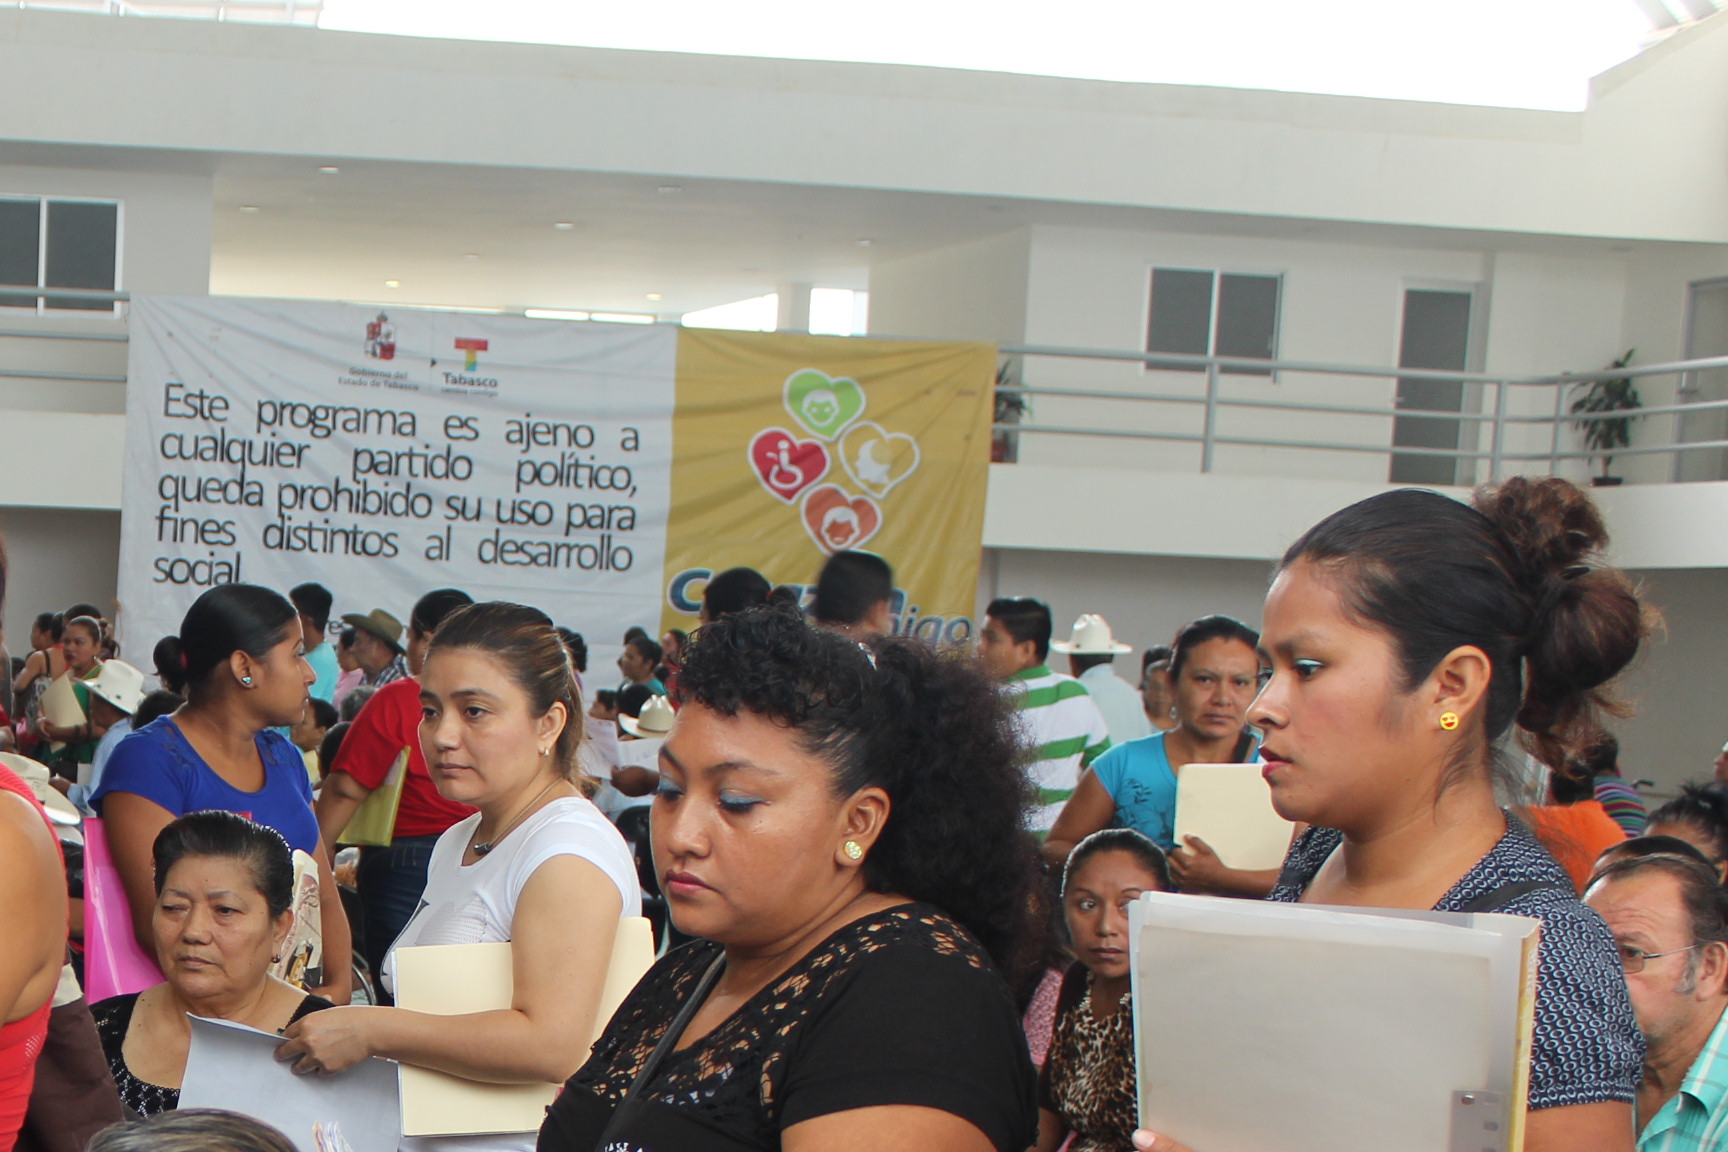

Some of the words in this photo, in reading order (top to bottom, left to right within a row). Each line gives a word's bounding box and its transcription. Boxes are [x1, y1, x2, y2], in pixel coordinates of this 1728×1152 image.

[338, 376, 368, 387] Estado
[369, 379, 381, 388] de
[383, 380, 420, 391] Tabasco
[349, 366, 391, 378] Gobierno
[442, 372, 498, 387] Tabasco
[164, 383, 229, 422] Este
[257, 396, 416, 438] programa
[444, 414, 479, 440] es
[505, 413, 594, 453] ajeno
[620, 426, 639, 452] a
[159, 427, 310, 471] cualquier
[353, 444, 474, 482] partido
[516, 453, 638, 497] político,
[158, 464, 264, 511] queda
[278, 478, 433, 520] prohibido
[445, 496, 482, 522] su
[497, 499, 553, 527] uso
[565, 502, 636, 535] para
[154, 507, 236, 548] fines
[262, 515, 399, 558] distintos
[425, 526, 451, 561] al
[478, 530, 633, 571] desarrollo
